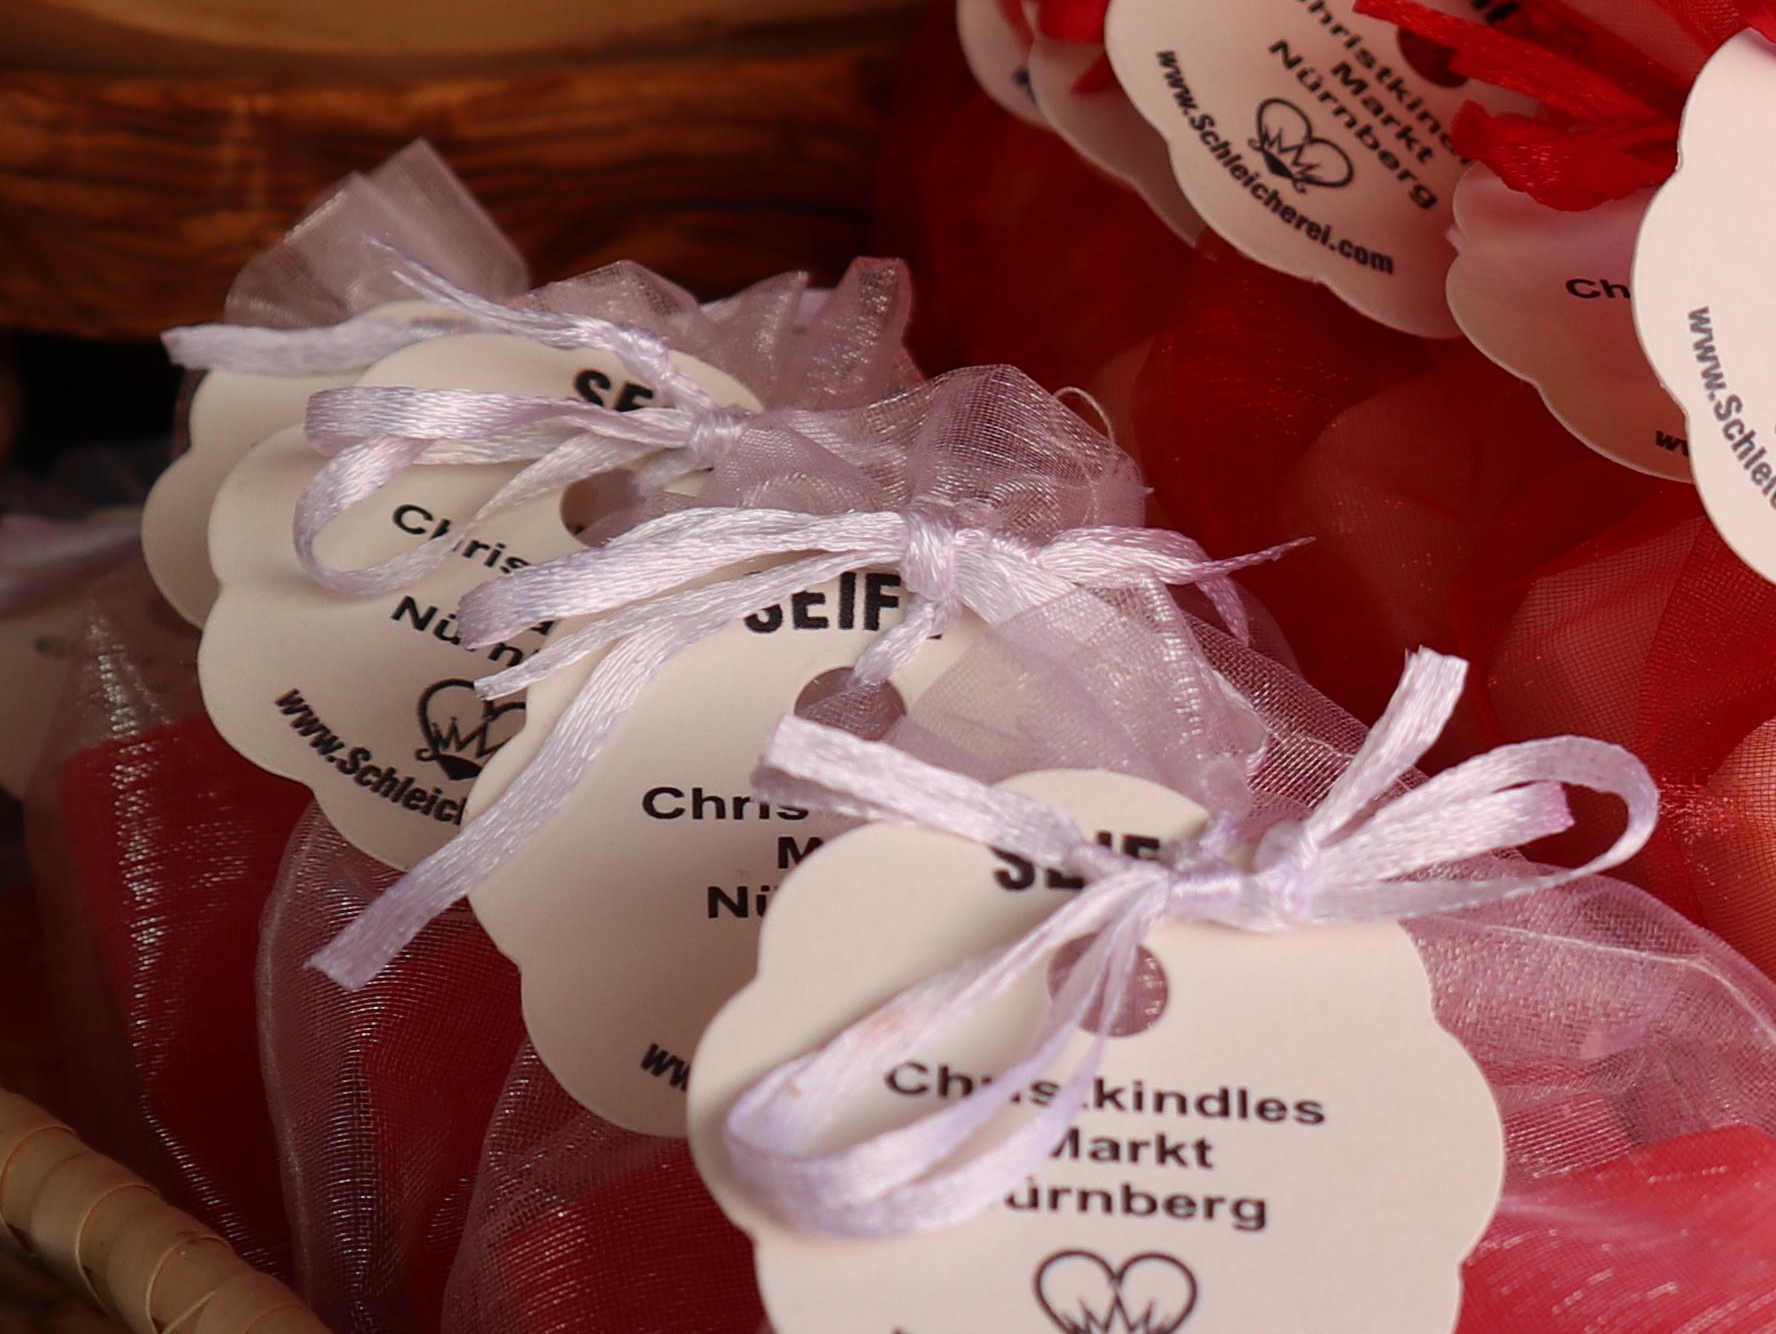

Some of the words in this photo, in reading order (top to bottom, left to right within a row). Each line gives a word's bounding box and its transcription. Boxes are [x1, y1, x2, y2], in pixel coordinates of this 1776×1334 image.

[1156, 49, 1396, 275] www.Schleicherei.com
[1267, 39, 1439, 210] Nürnberg
[1331, 62, 1435, 165] Markt
[743, 570, 942, 641] SEIF
[1003, 1175, 1269, 1233] ürnberg
